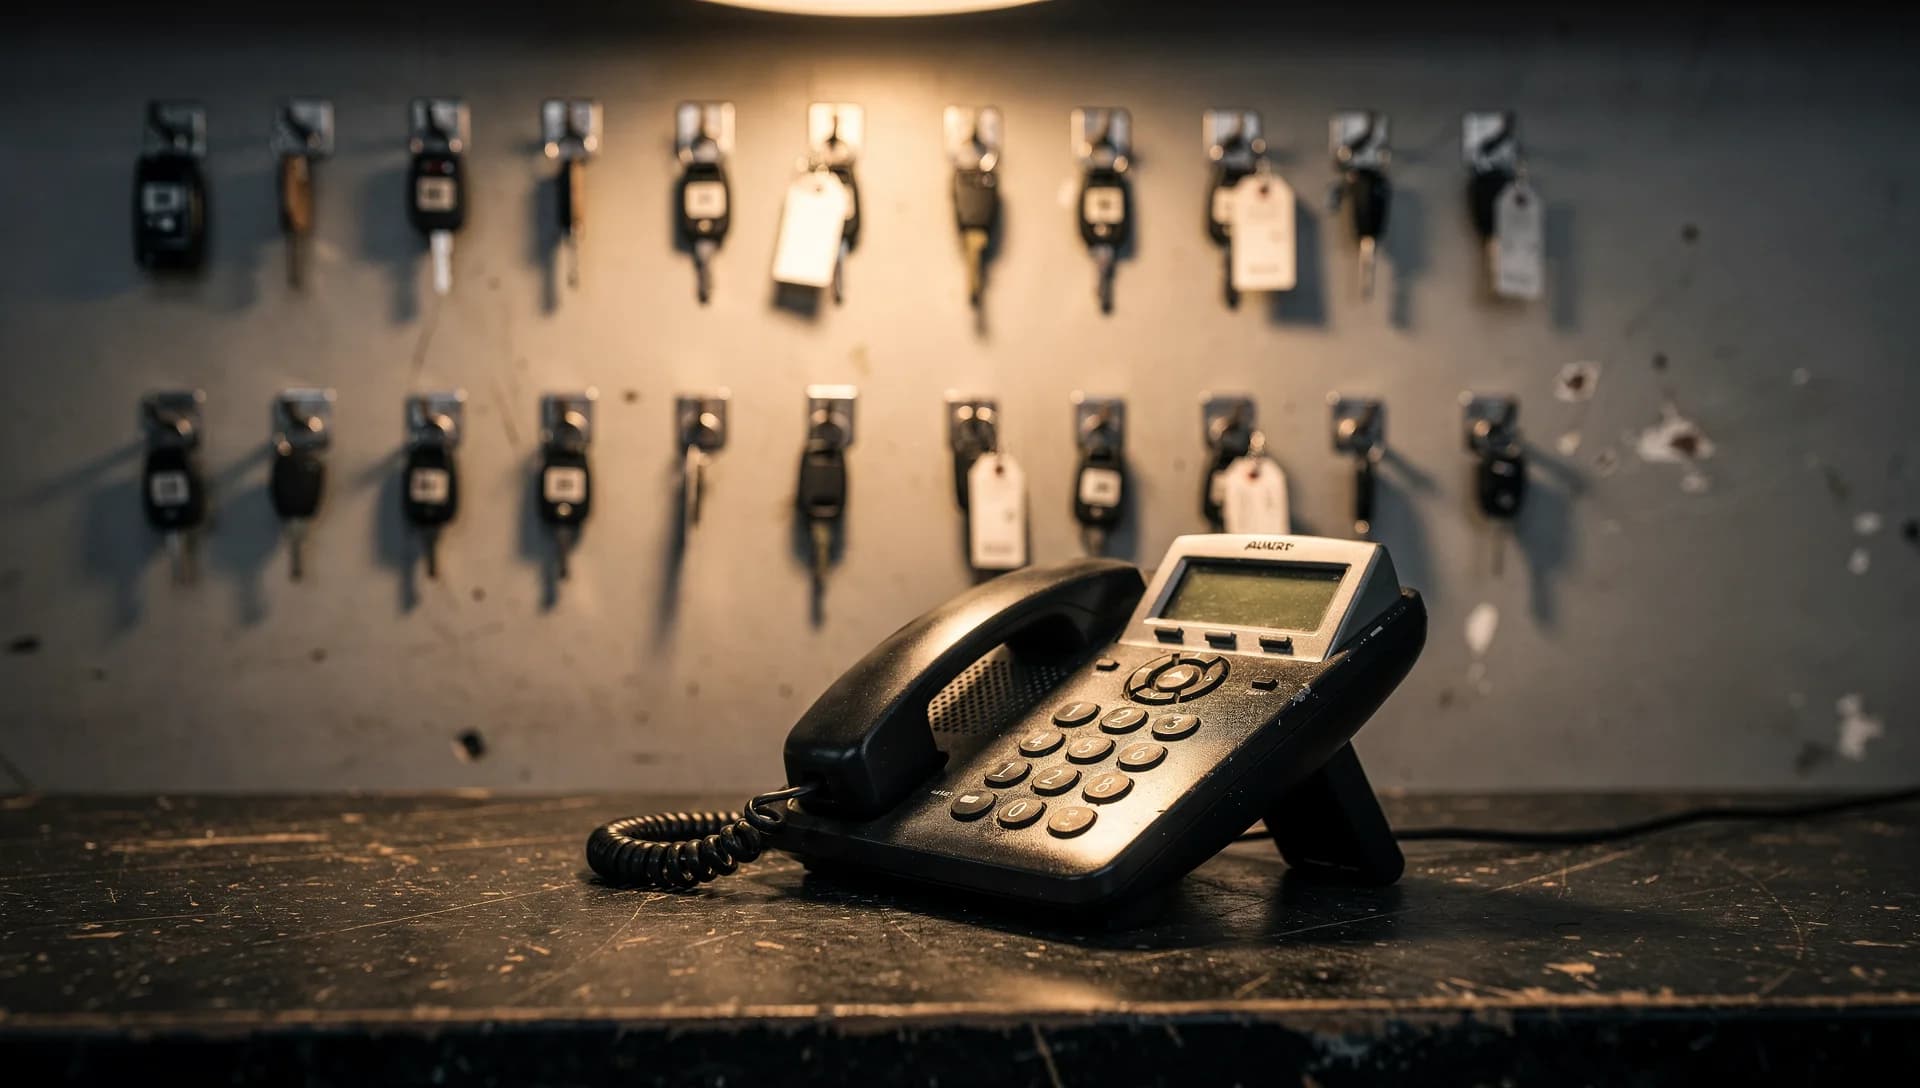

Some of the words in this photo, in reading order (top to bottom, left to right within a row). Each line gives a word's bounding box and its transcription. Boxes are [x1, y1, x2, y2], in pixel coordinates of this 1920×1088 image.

[1068, 703, 1082, 717] 1
[1111, 709, 1131, 724] 2
[1164, 716, 1184, 730] 3
[1030, 731, 1049, 748] 4
[1077, 739, 1098, 753] 5
[1130, 746, 1149, 760] 6
[992, 762, 1015, 778] 1
[1040, 769, 1062, 785] 2
[1095, 777, 1114, 793] 8
[1007, 801, 1028, 817] 0
